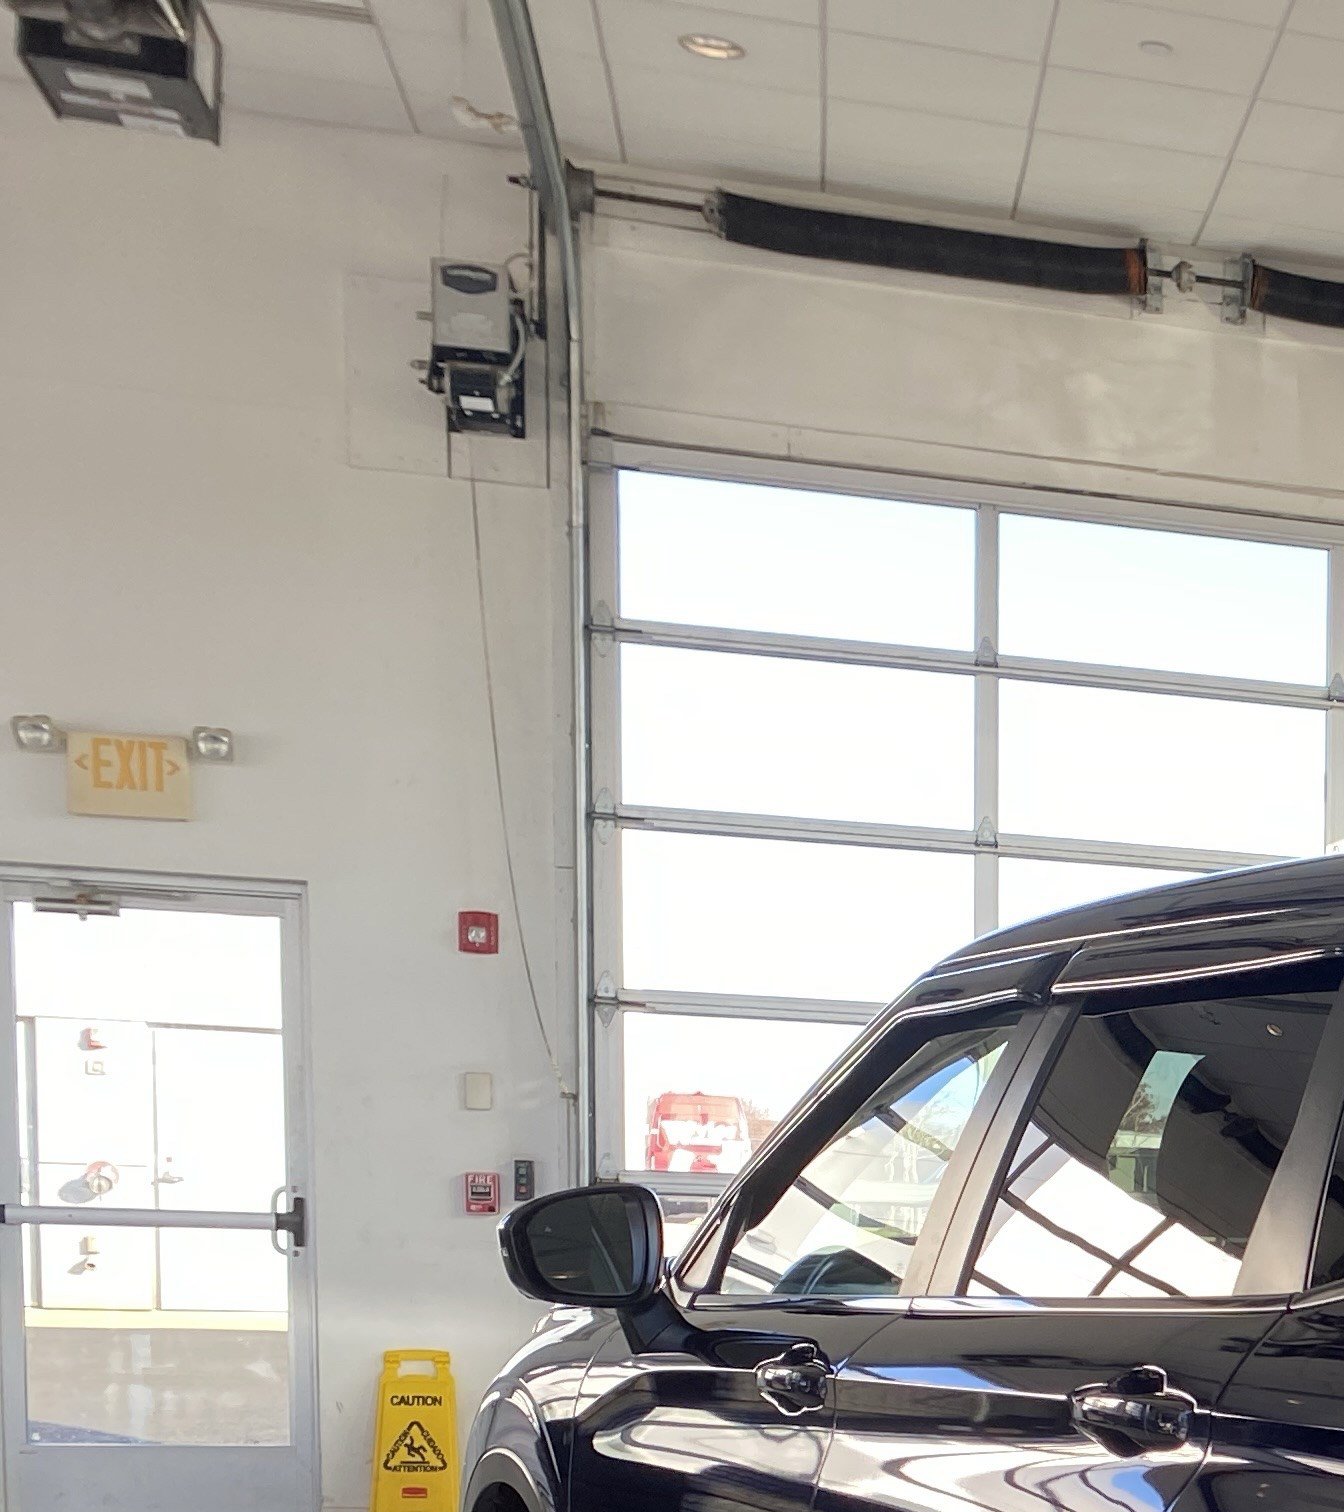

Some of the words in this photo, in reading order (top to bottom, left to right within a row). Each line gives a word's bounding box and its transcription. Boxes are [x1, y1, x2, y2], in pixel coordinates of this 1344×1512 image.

[91, 737, 168, 792] EXIT
[467, 1174, 493, 1184] FIRE
[390, 1395, 442, 1407] CAUTION
[391, 1464, 439, 1473] ATTENTION
